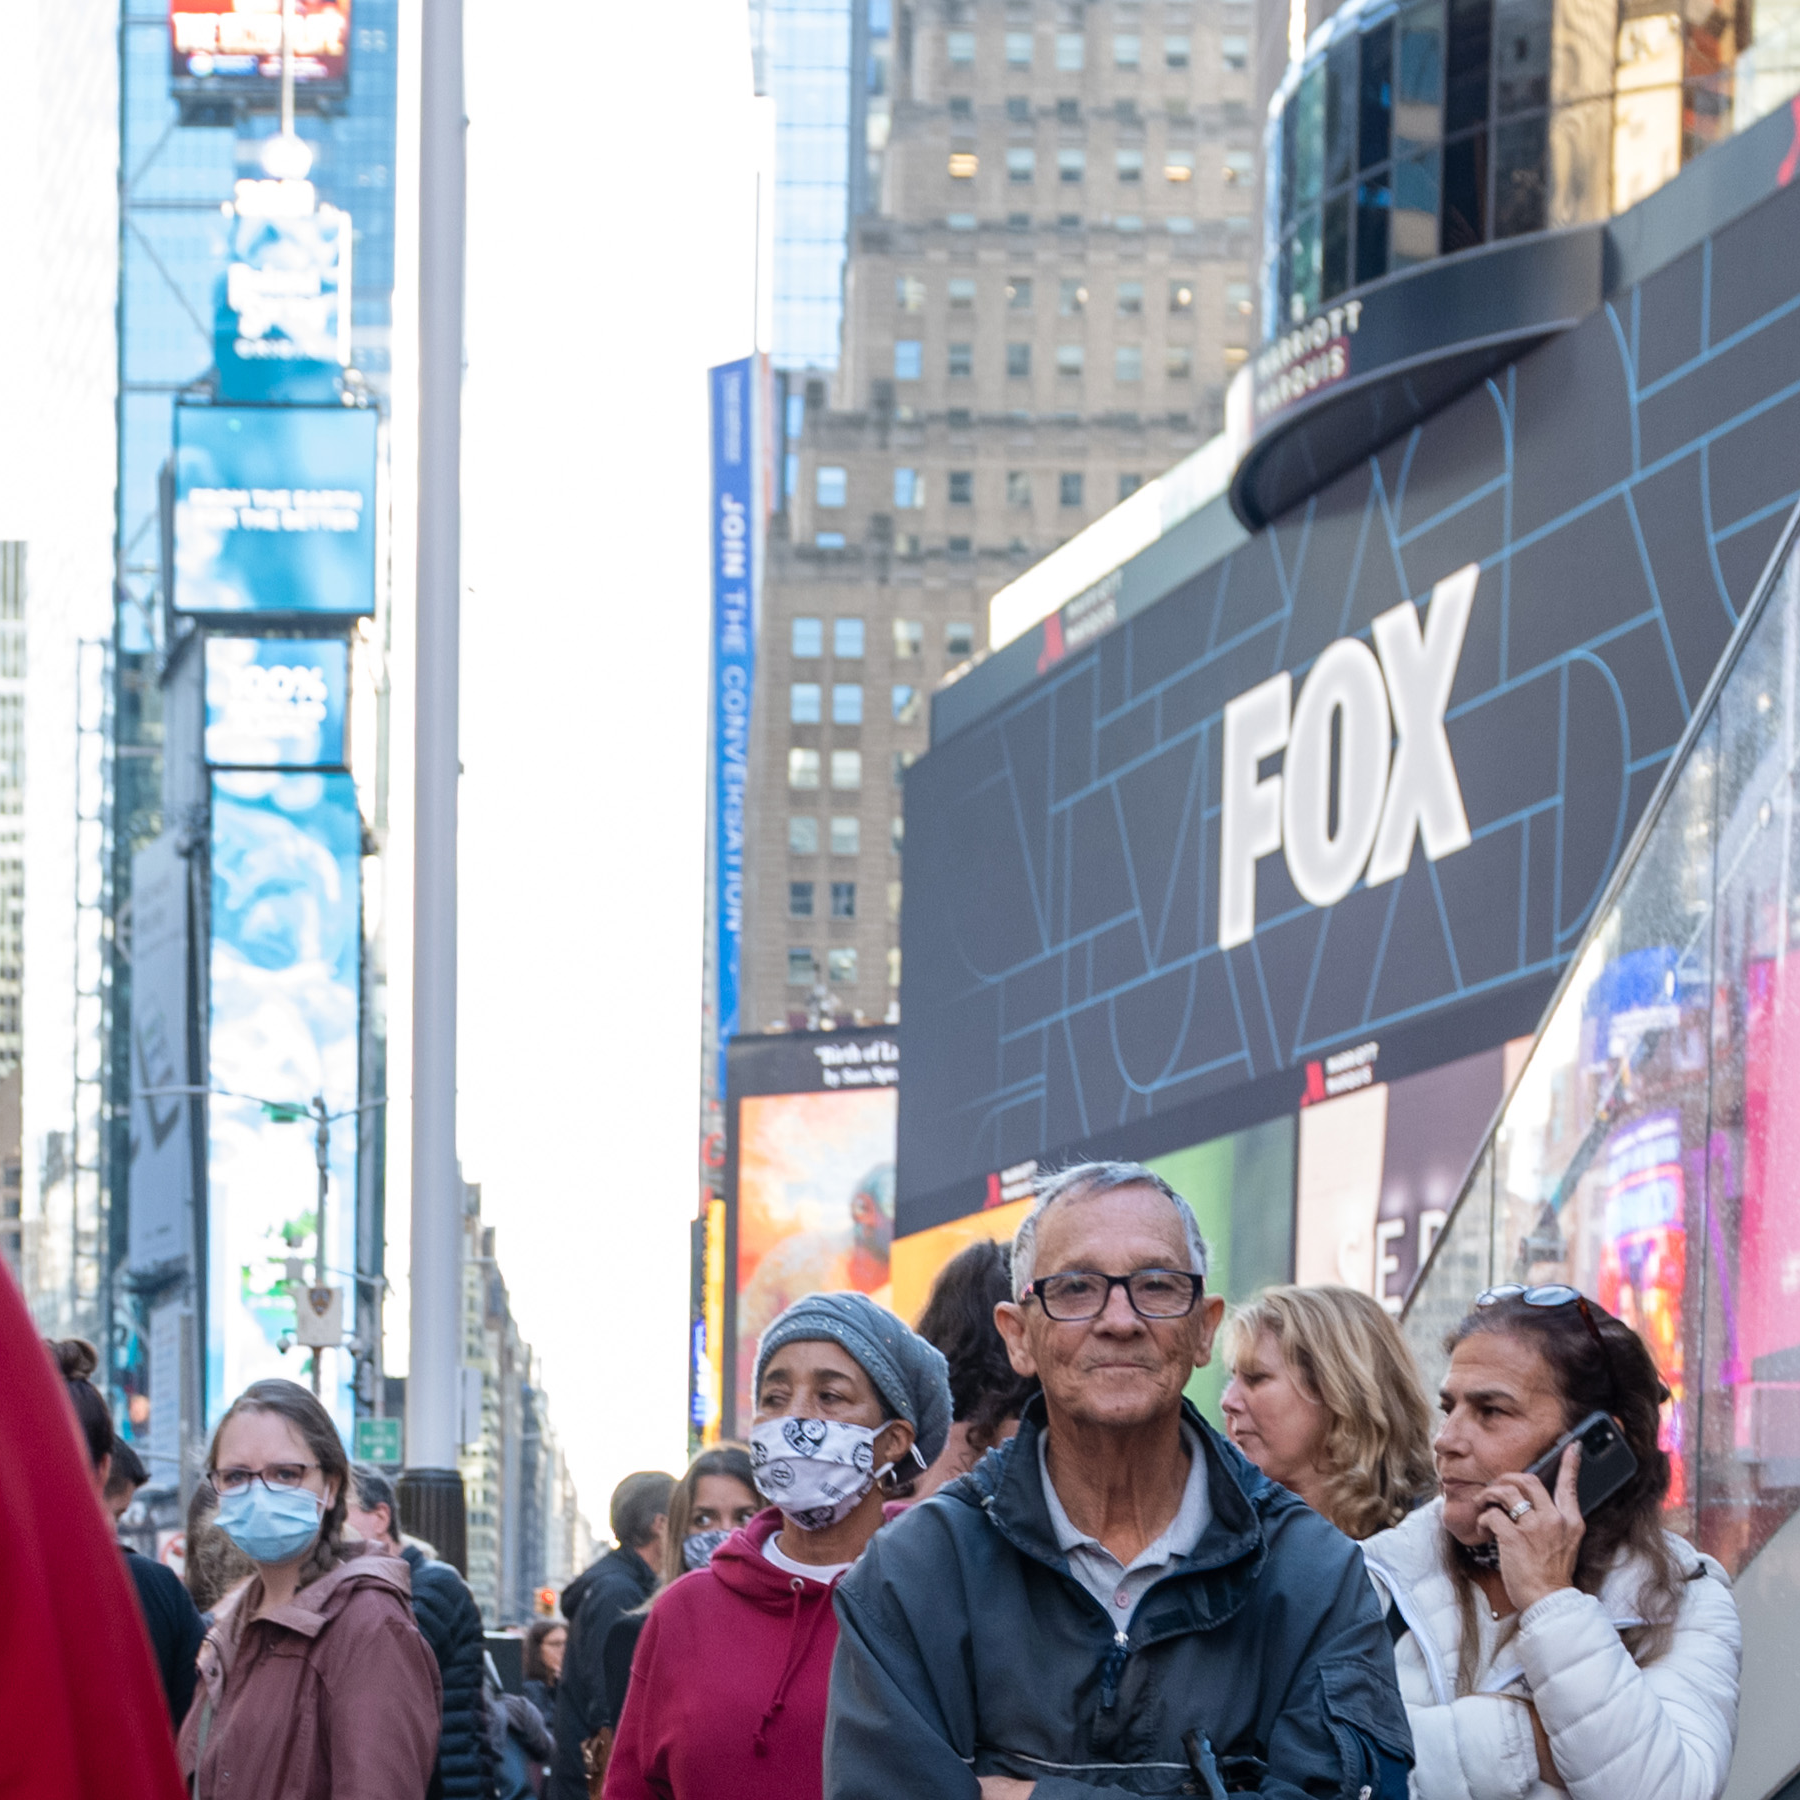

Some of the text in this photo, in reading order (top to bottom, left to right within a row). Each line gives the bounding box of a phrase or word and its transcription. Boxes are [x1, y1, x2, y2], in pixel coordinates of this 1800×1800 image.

[721, 493, 747, 578] JOIN
[721, 588, 747, 656] THE
[1218, 562, 1481, 951] FOX
